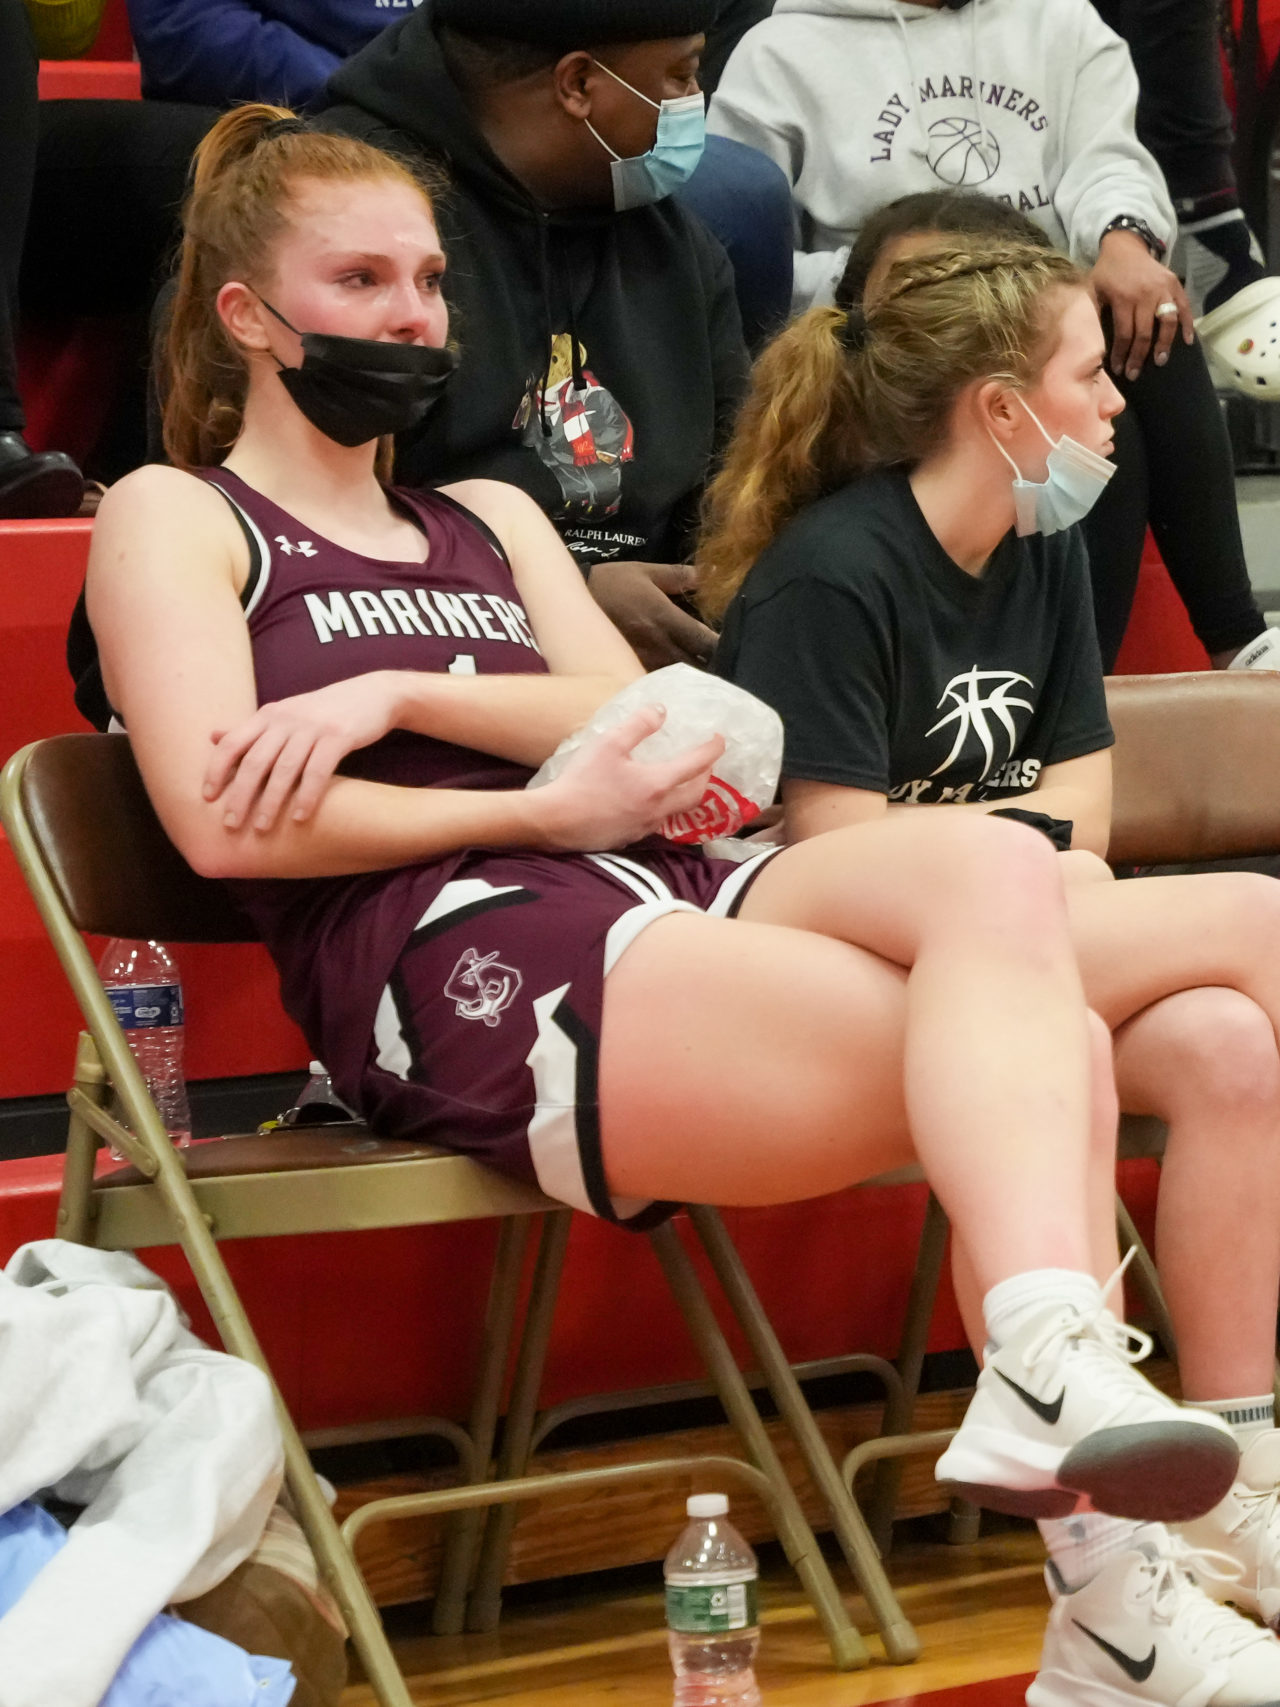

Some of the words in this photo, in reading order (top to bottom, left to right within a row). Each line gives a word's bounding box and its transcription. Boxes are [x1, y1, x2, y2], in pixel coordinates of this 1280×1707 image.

[870, 92, 910, 163] LADY
[919, 74, 1048, 132] MARINERS
[564, 528, 602, 541] RALPH
[604, 531, 649, 547] LAUREN
[303, 588, 542, 655] MARINERS
